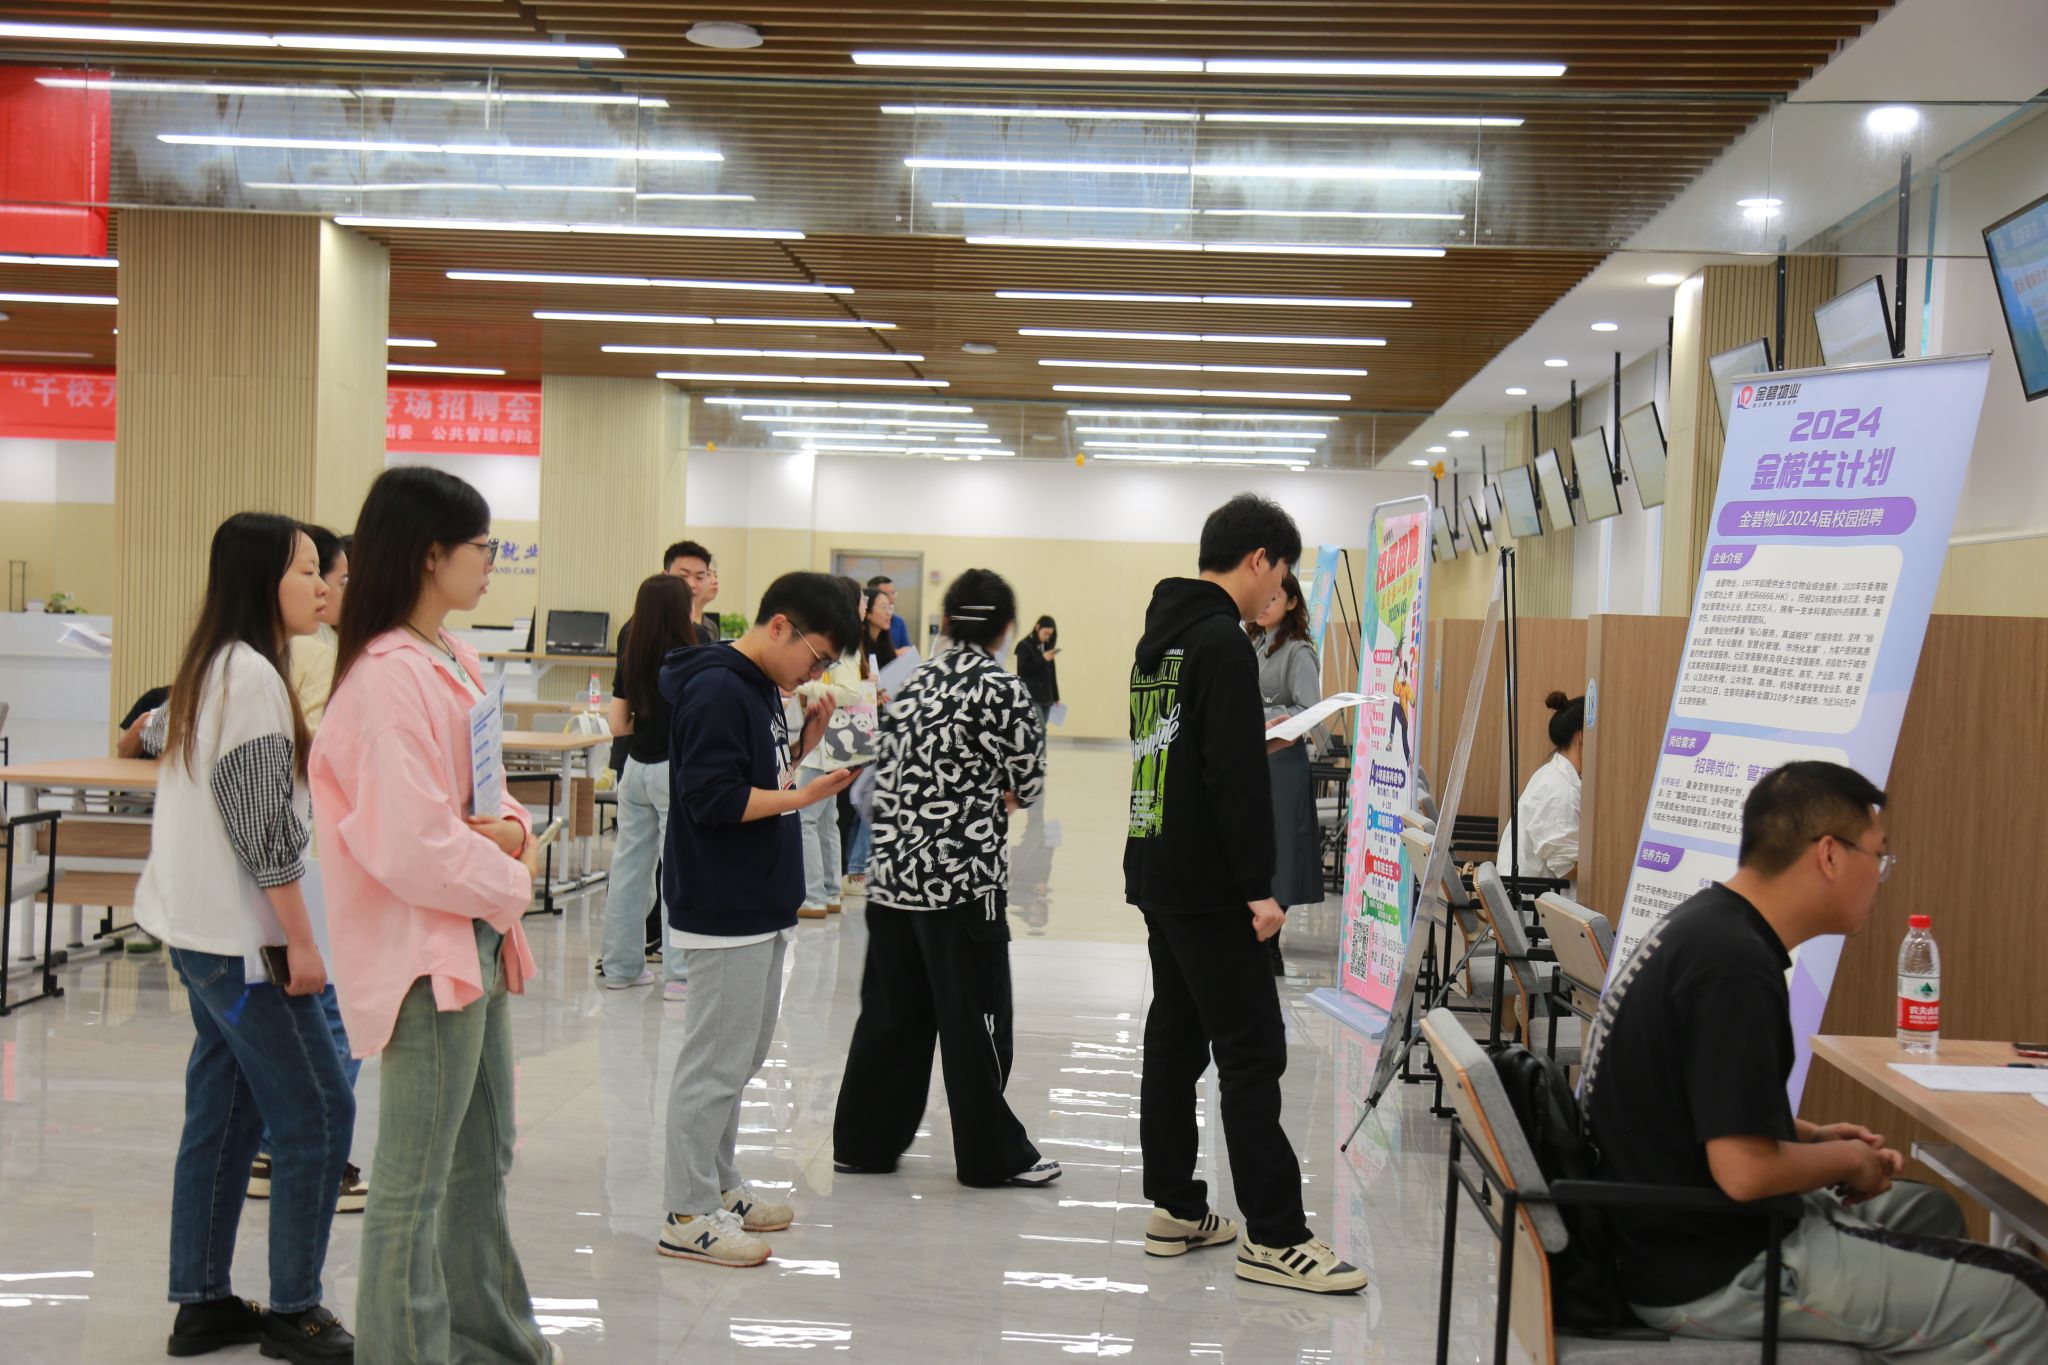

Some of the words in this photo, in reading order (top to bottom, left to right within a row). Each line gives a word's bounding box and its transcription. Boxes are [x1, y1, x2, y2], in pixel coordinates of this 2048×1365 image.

[1755, 383, 1802, 401] 金碧物业
[1789, 406, 1883, 442] 2024
[431, 425, 534, 444] 公共管理学院
[1750, 446, 1896, 491] 金榜生计划
[1738, 508, 1885, 528] 金碧物业2024届校园招聘
[1711, 551, 1744, 565] 企业介绍
[1668, 735, 1697, 750] 岗位需求
[1641, 848, 1671, 865] 培养方向
